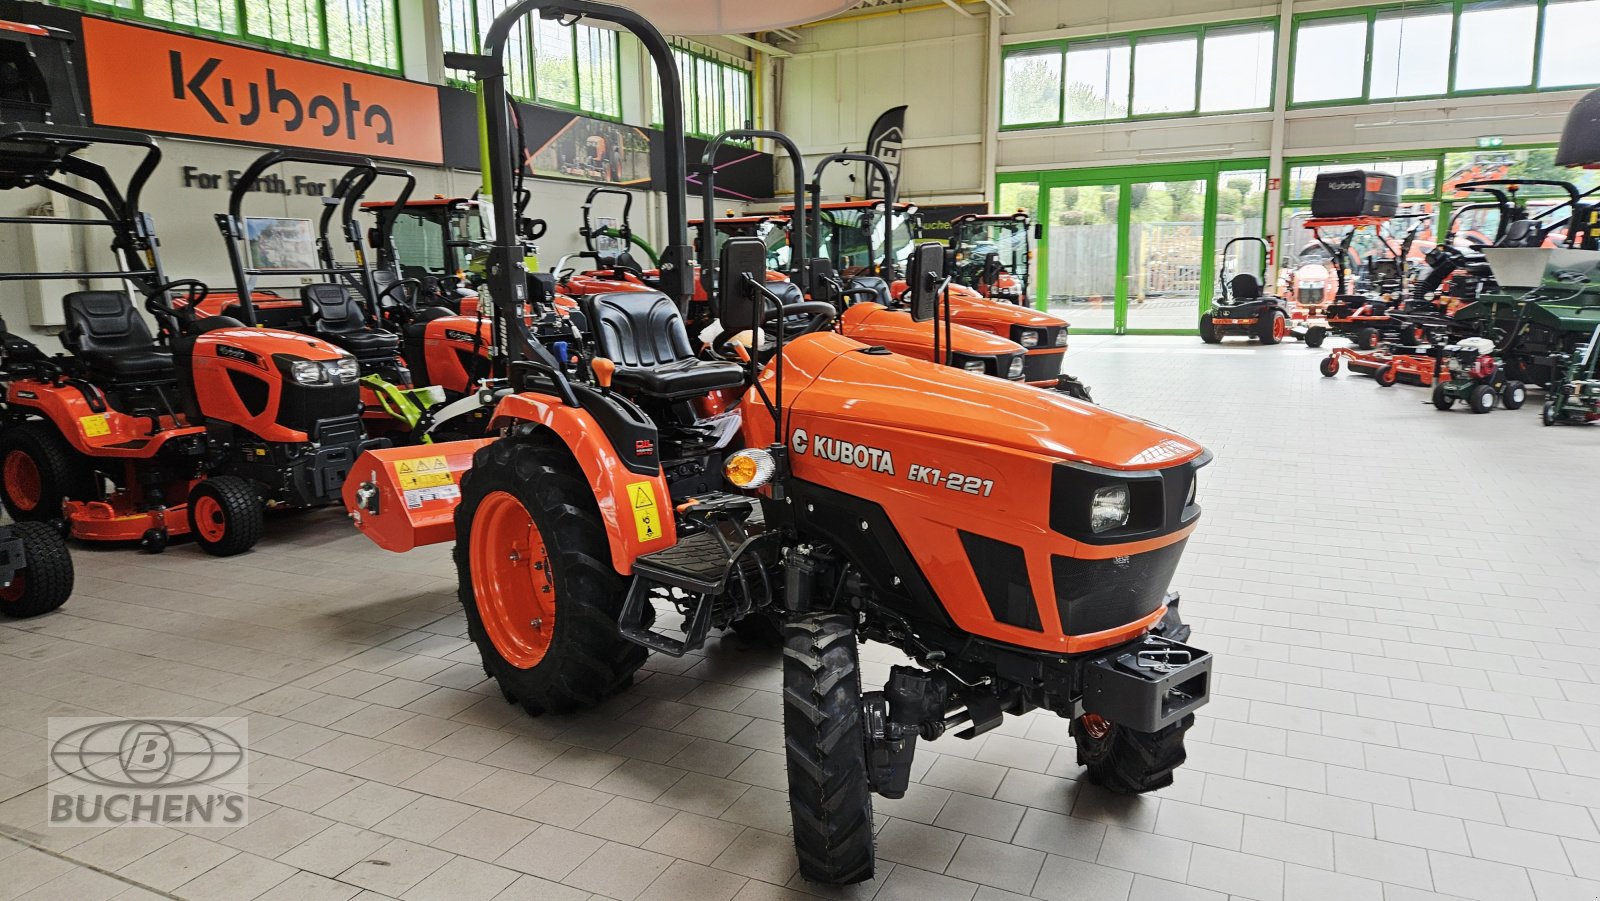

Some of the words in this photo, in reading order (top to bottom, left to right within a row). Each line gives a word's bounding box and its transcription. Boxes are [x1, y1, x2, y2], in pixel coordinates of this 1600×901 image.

[169, 50, 395, 145] Kubota
[182, 166, 221, 190] For
[228, 170, 292, 196] Erth,
[294, 175, 326, 197] For
[813, 435, 895, 476] KUBOTA
[907, 463, 994, 497] EK1-221
